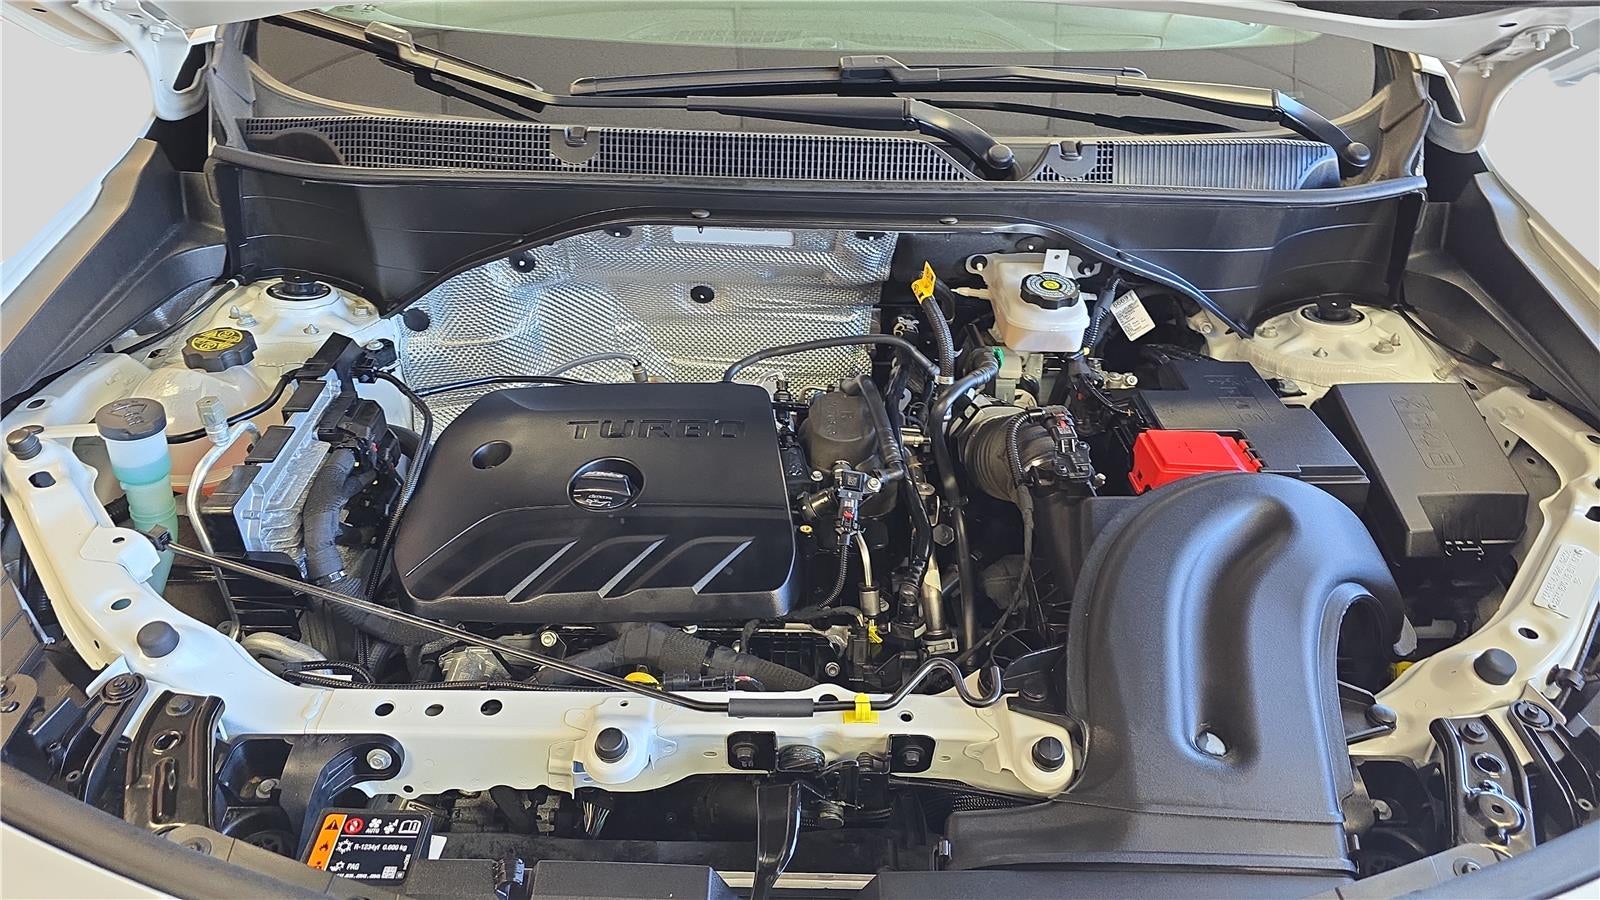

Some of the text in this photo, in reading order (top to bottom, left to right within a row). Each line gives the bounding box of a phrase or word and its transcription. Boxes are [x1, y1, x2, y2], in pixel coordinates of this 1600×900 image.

[567, 419, 746, 440] TURBO
[354, 843, 381, 852] R-1234yf
[399, 844, 408, 852] kg
[346, 863, 360, 871] PAG
